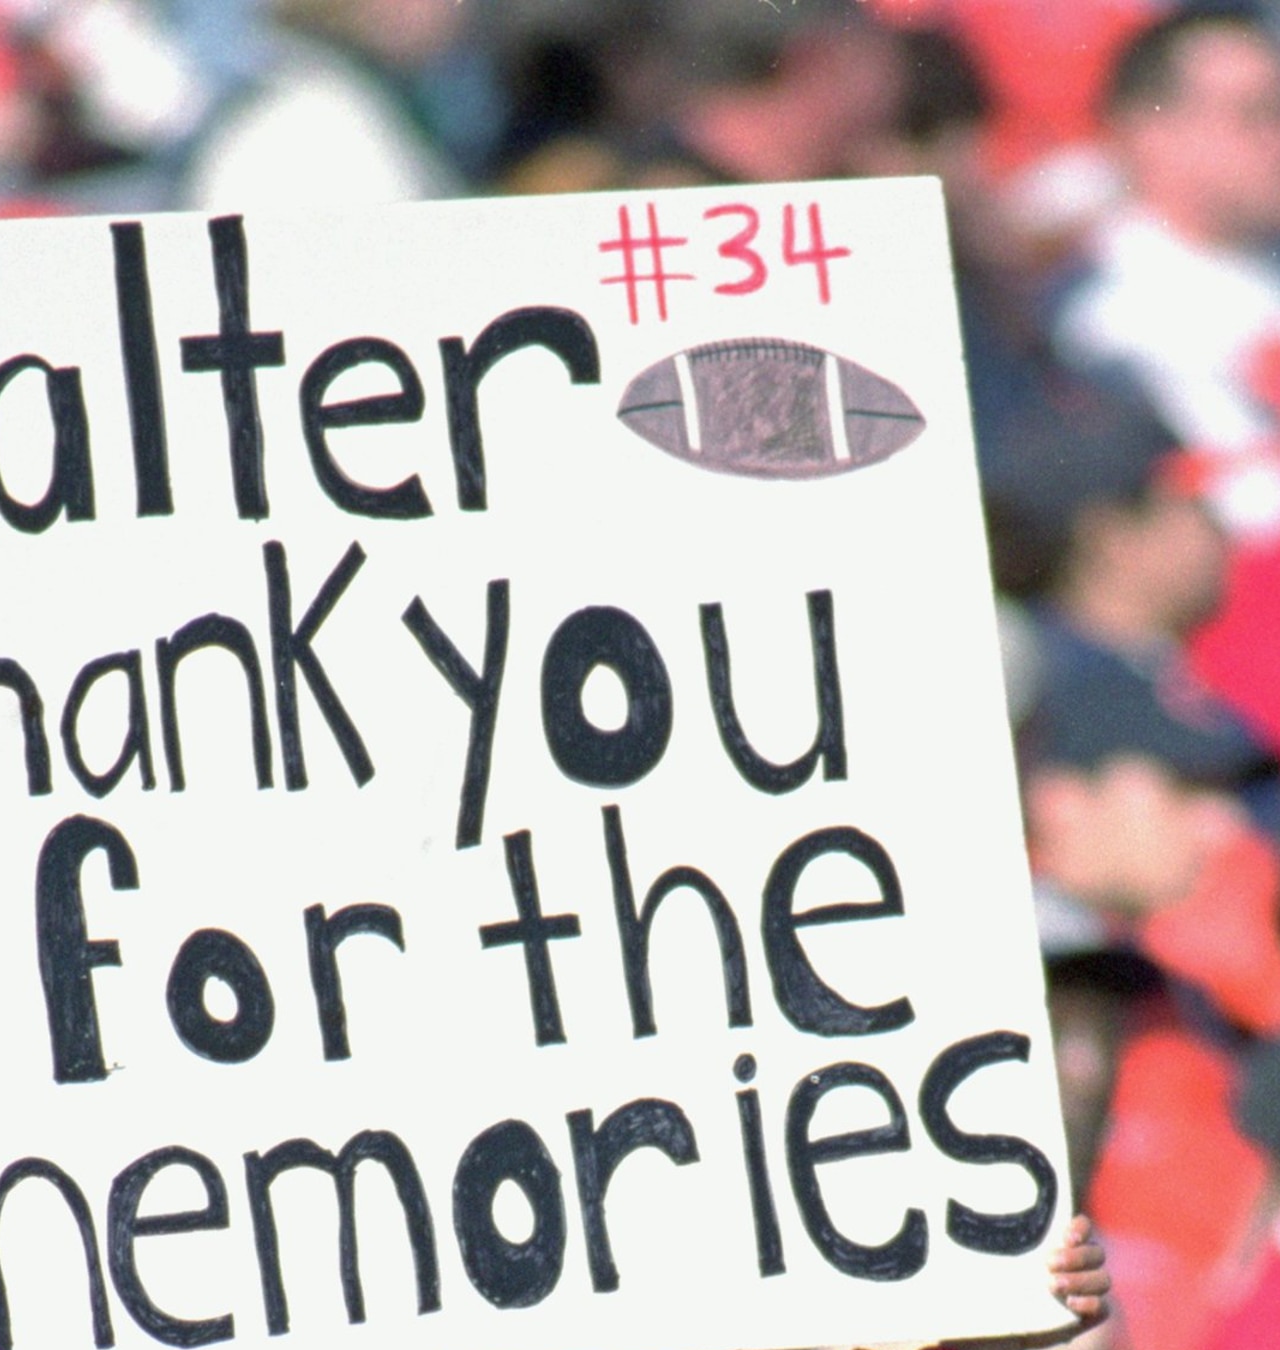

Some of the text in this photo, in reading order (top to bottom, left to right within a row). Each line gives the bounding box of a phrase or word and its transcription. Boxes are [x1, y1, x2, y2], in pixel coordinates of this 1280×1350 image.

[597, 202, 852, 325] #34
[402, 579, 848, 851] you
[36, 805, 916, 1084] for the
